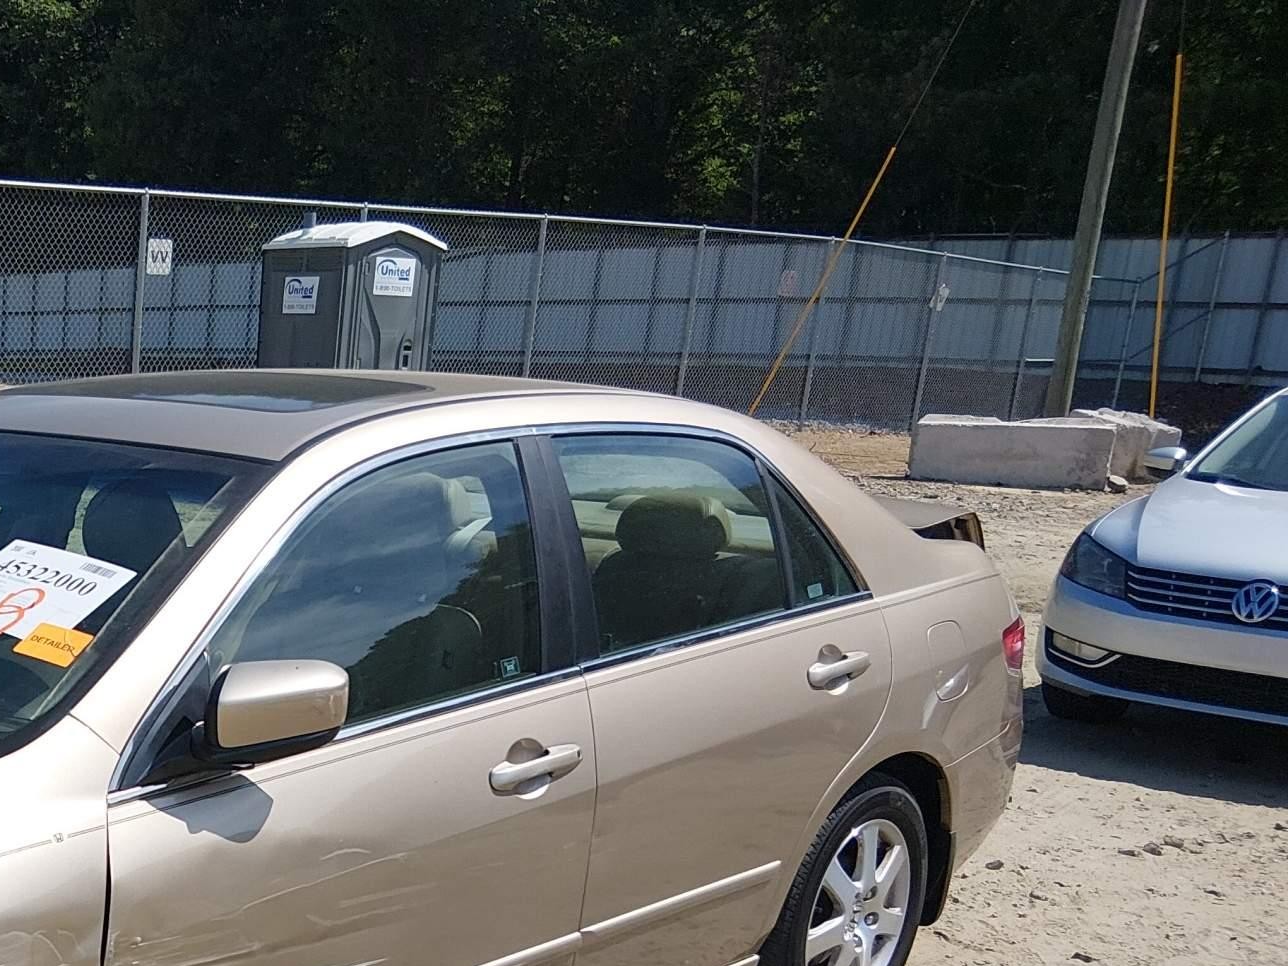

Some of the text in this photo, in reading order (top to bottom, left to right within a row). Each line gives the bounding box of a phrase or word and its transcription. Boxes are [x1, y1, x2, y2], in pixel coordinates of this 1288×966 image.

[380, 265, 411, 279] United
[287, 282, 314, 296] United
[30, 635, 76, 654] DETAILER
